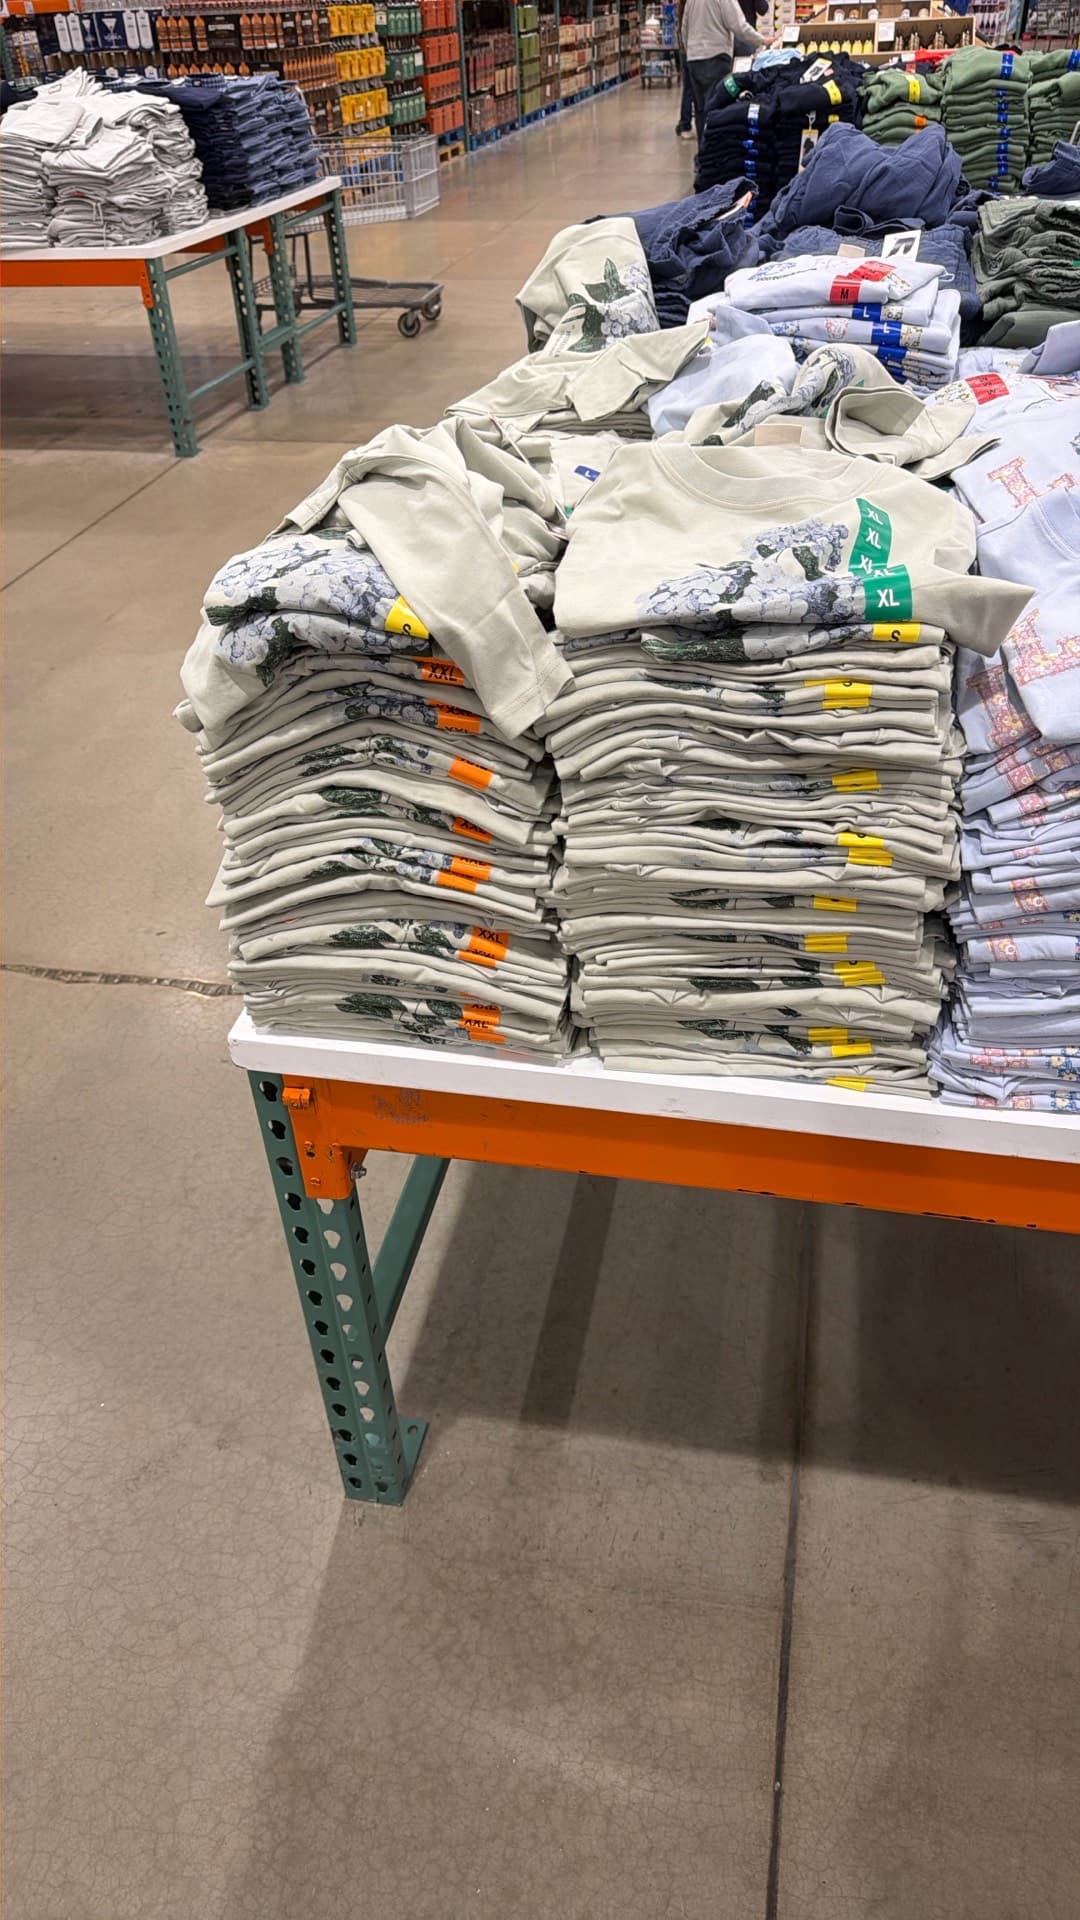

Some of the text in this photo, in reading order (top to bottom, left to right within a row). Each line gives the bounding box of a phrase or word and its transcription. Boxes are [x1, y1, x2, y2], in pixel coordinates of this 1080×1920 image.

[840, 287, 849, 300] M
[863, 305, 870, 318] L
[883, 321, 891, 334] L
[584, 470, 592, 478] L
[867, 507, 884, 526] XL
[865, 527, 882, 550] XL
[858, 554, 874, 575] XL
[877, 588, 901, 609] XL
[402, 623, 412, 636] S
[889, 629, 902, 642] S
[428, 664, 459, 682] XXL
[478, 926, 504, 945] XXL
